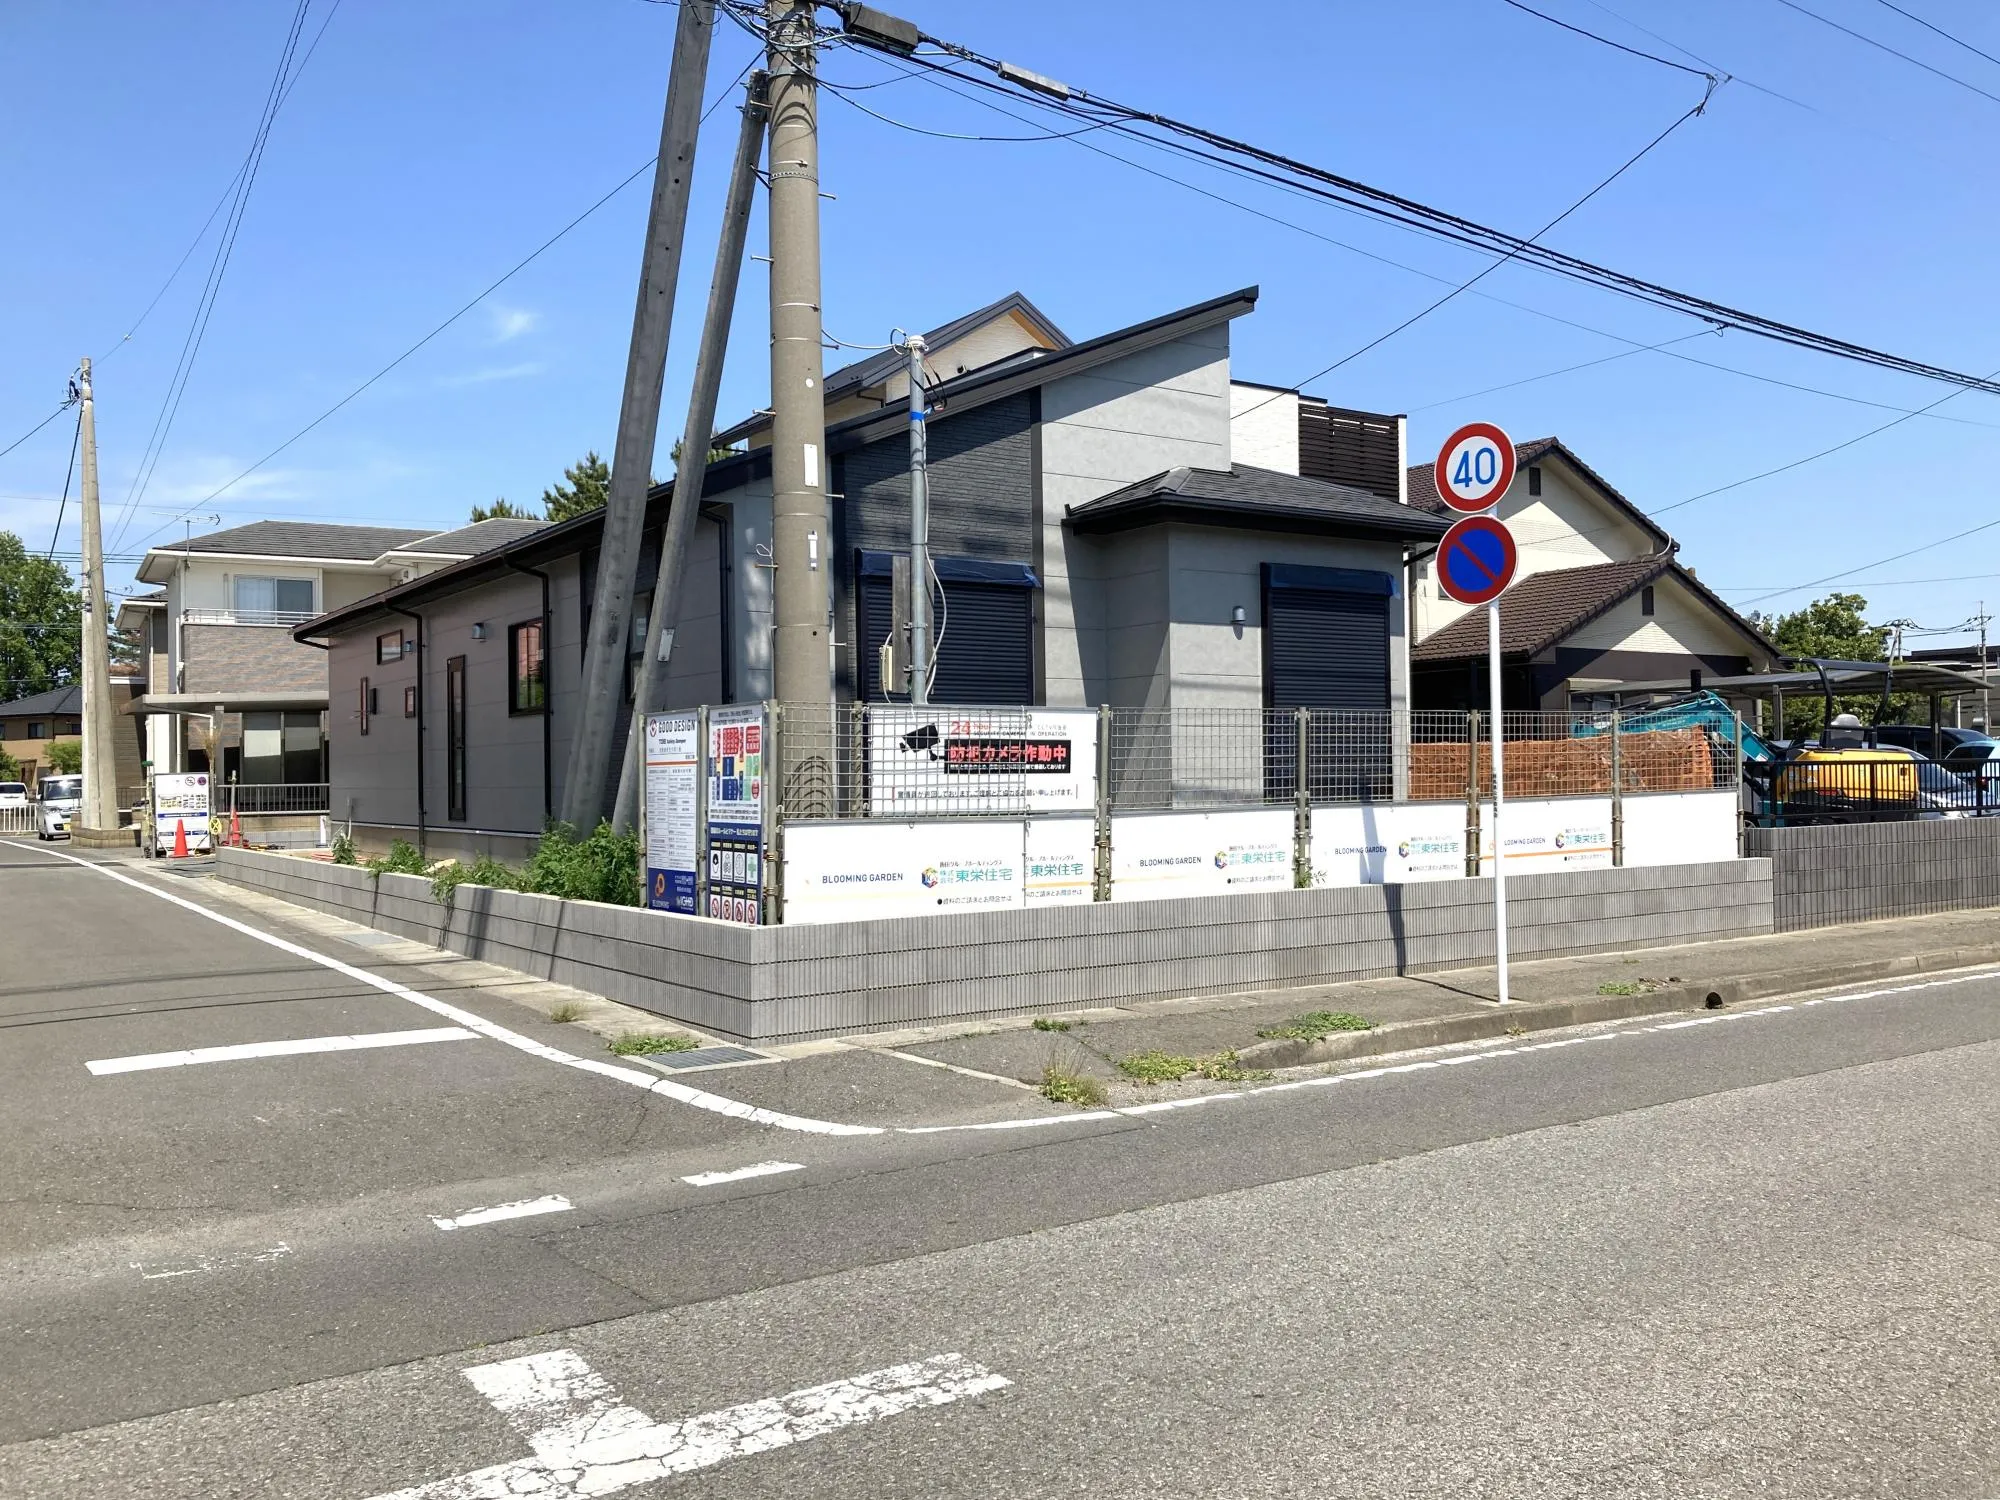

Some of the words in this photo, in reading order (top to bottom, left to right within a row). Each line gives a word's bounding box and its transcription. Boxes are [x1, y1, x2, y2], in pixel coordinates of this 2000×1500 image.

[1453, 447, 1496, 488] 40
[658, 721, 673, 733] GOOD
[674, 720, 696, 732] DESIGN
[950, 720, 970, 735] 24
[949, 744, 1067, 762] 防犯カメラ作動中
[1503, 838, 1526, 846] LOOMING
[1526, 837, 1546, 845] GARDEN
[1334, 847, 1364, 855] BLOOMING
[1364, 845, 1387, 853] GARDEN
[1139, 857, 1174, 867] BLOOMING
[1175, 856, 1202, 865] GARDEN
[1241, 851, 1286, 865] 東栄住宅
[955, 868, 1013, 883] 東栄住宅
[1031, 863, 1083, 878] 東栄住宅
[822, 874, 868, 884] BLOOMING
[869, 872, 904, 882] GARDEN
